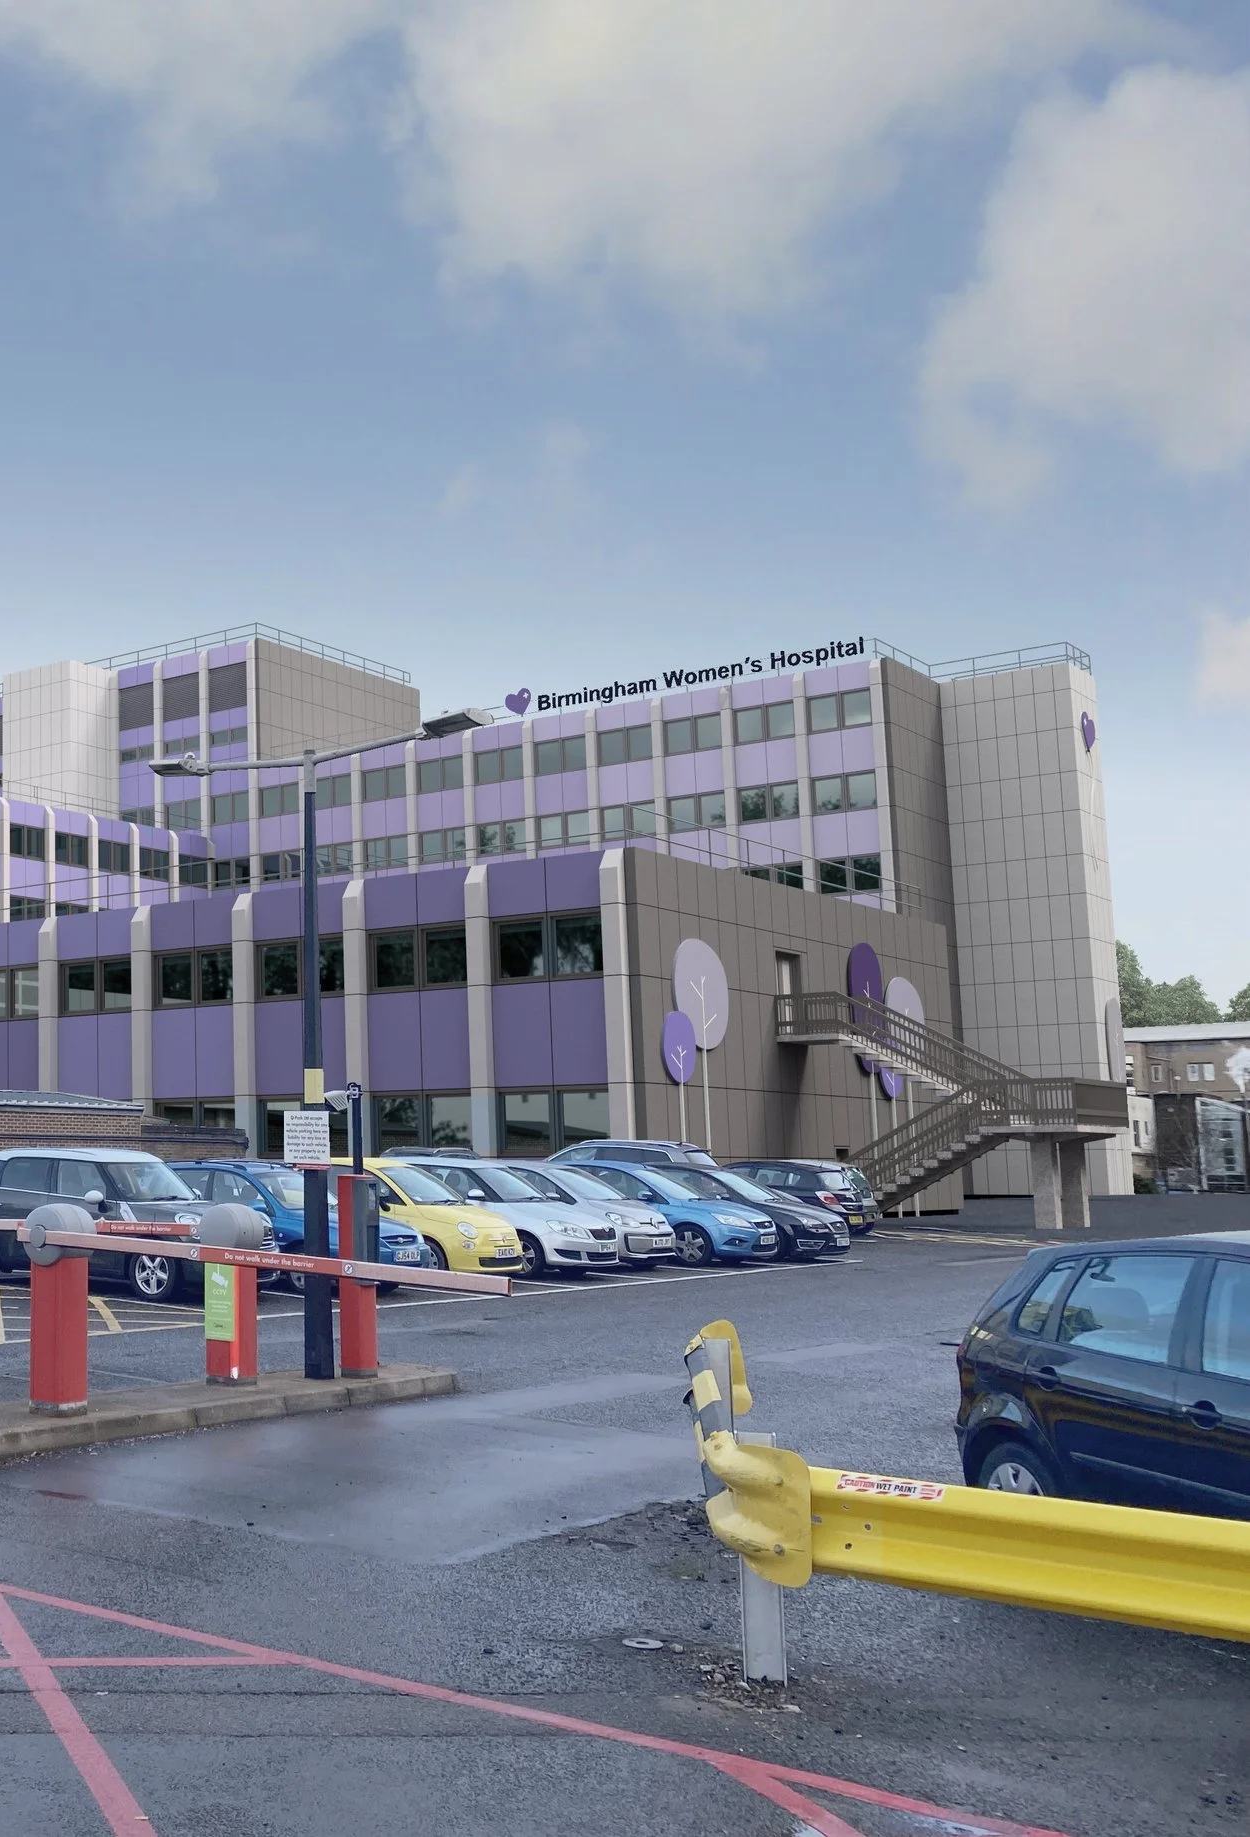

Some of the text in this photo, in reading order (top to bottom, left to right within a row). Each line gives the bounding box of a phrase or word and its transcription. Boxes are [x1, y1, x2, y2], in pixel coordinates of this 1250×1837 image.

[537, 636, 865, 712] Birmingham Women's Hospital
[224, 1252, 233, 1260] Do
[246, 1254, 260, 1263] walk
[262, 1257, 280, 1265] under
[281, 1258, 291, 1266] the
[293, 1259, 315, 1268] barrier
[844, 1479, 875, 1489] CAUTION
[876, 1482, 892, 1490] WET
[894, 1484, 918, 1494] PAINT
